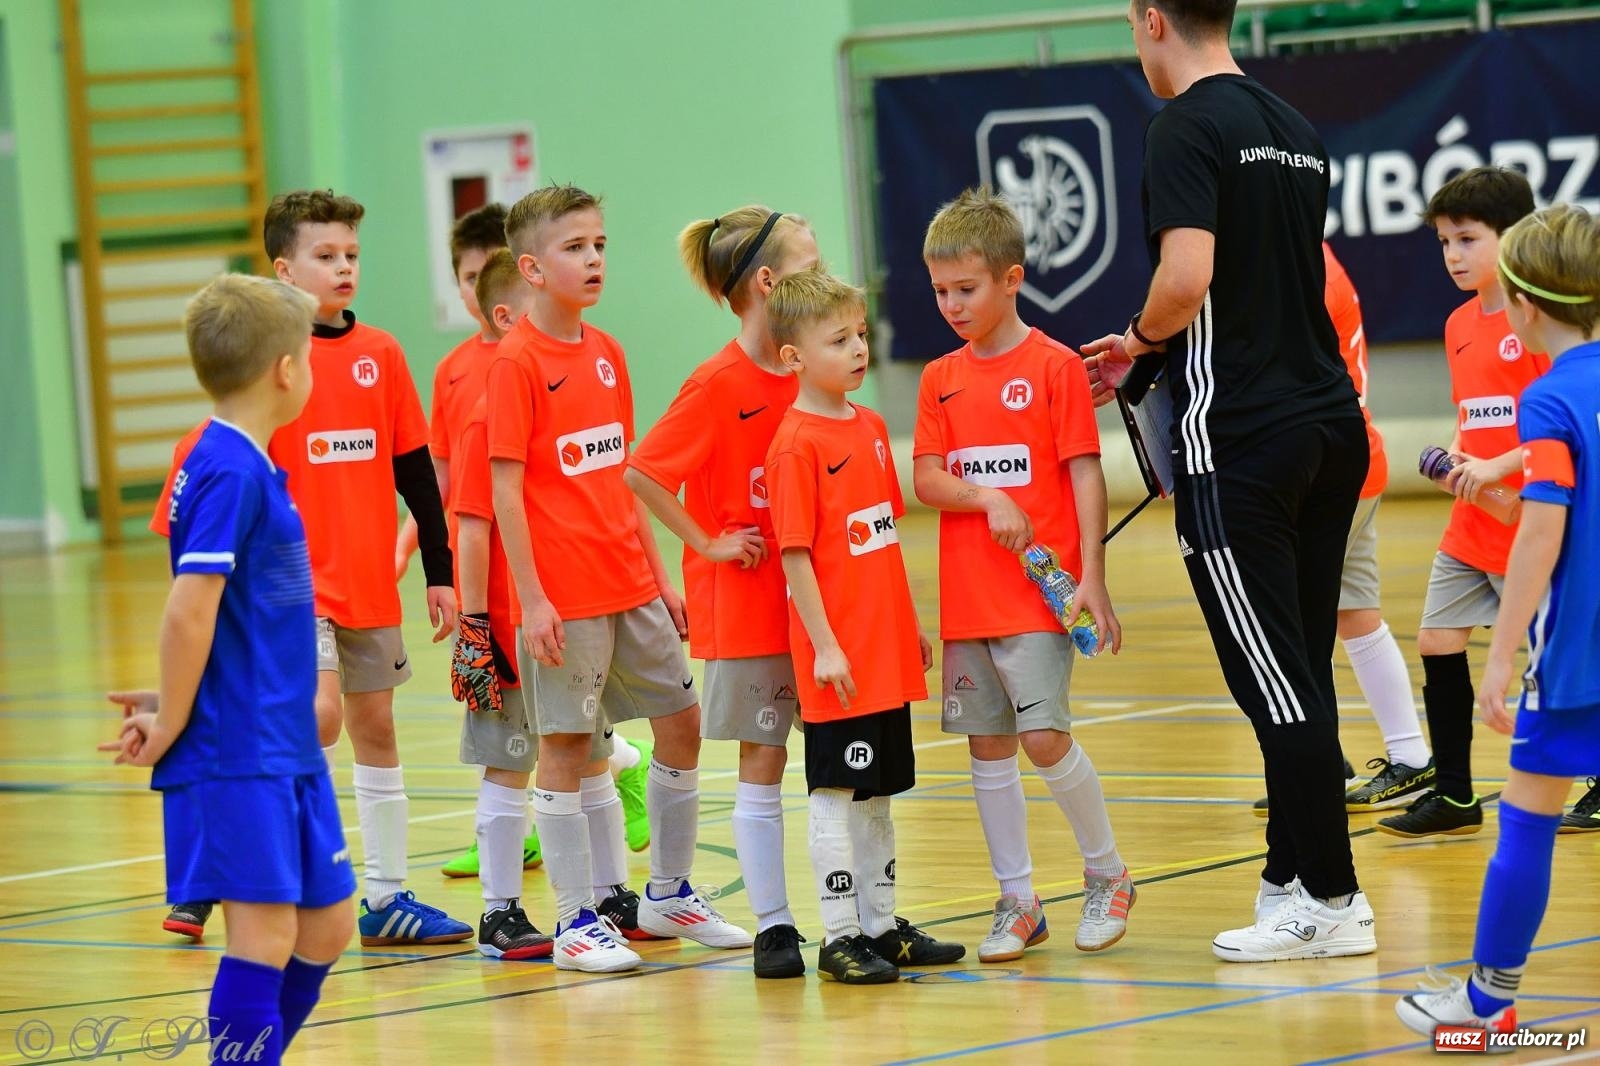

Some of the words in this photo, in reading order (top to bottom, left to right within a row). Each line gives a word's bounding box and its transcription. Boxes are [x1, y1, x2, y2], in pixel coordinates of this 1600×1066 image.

[1005, 383, 1027, 404] JR
[1469, 405, 1513, 419] PAKON
[332, 438, 374, 452] PAKON
[963, 457, 1028, 477] PAKON
[849, 746, 868, 763] JR
[831, 874, 850, 889] JR
